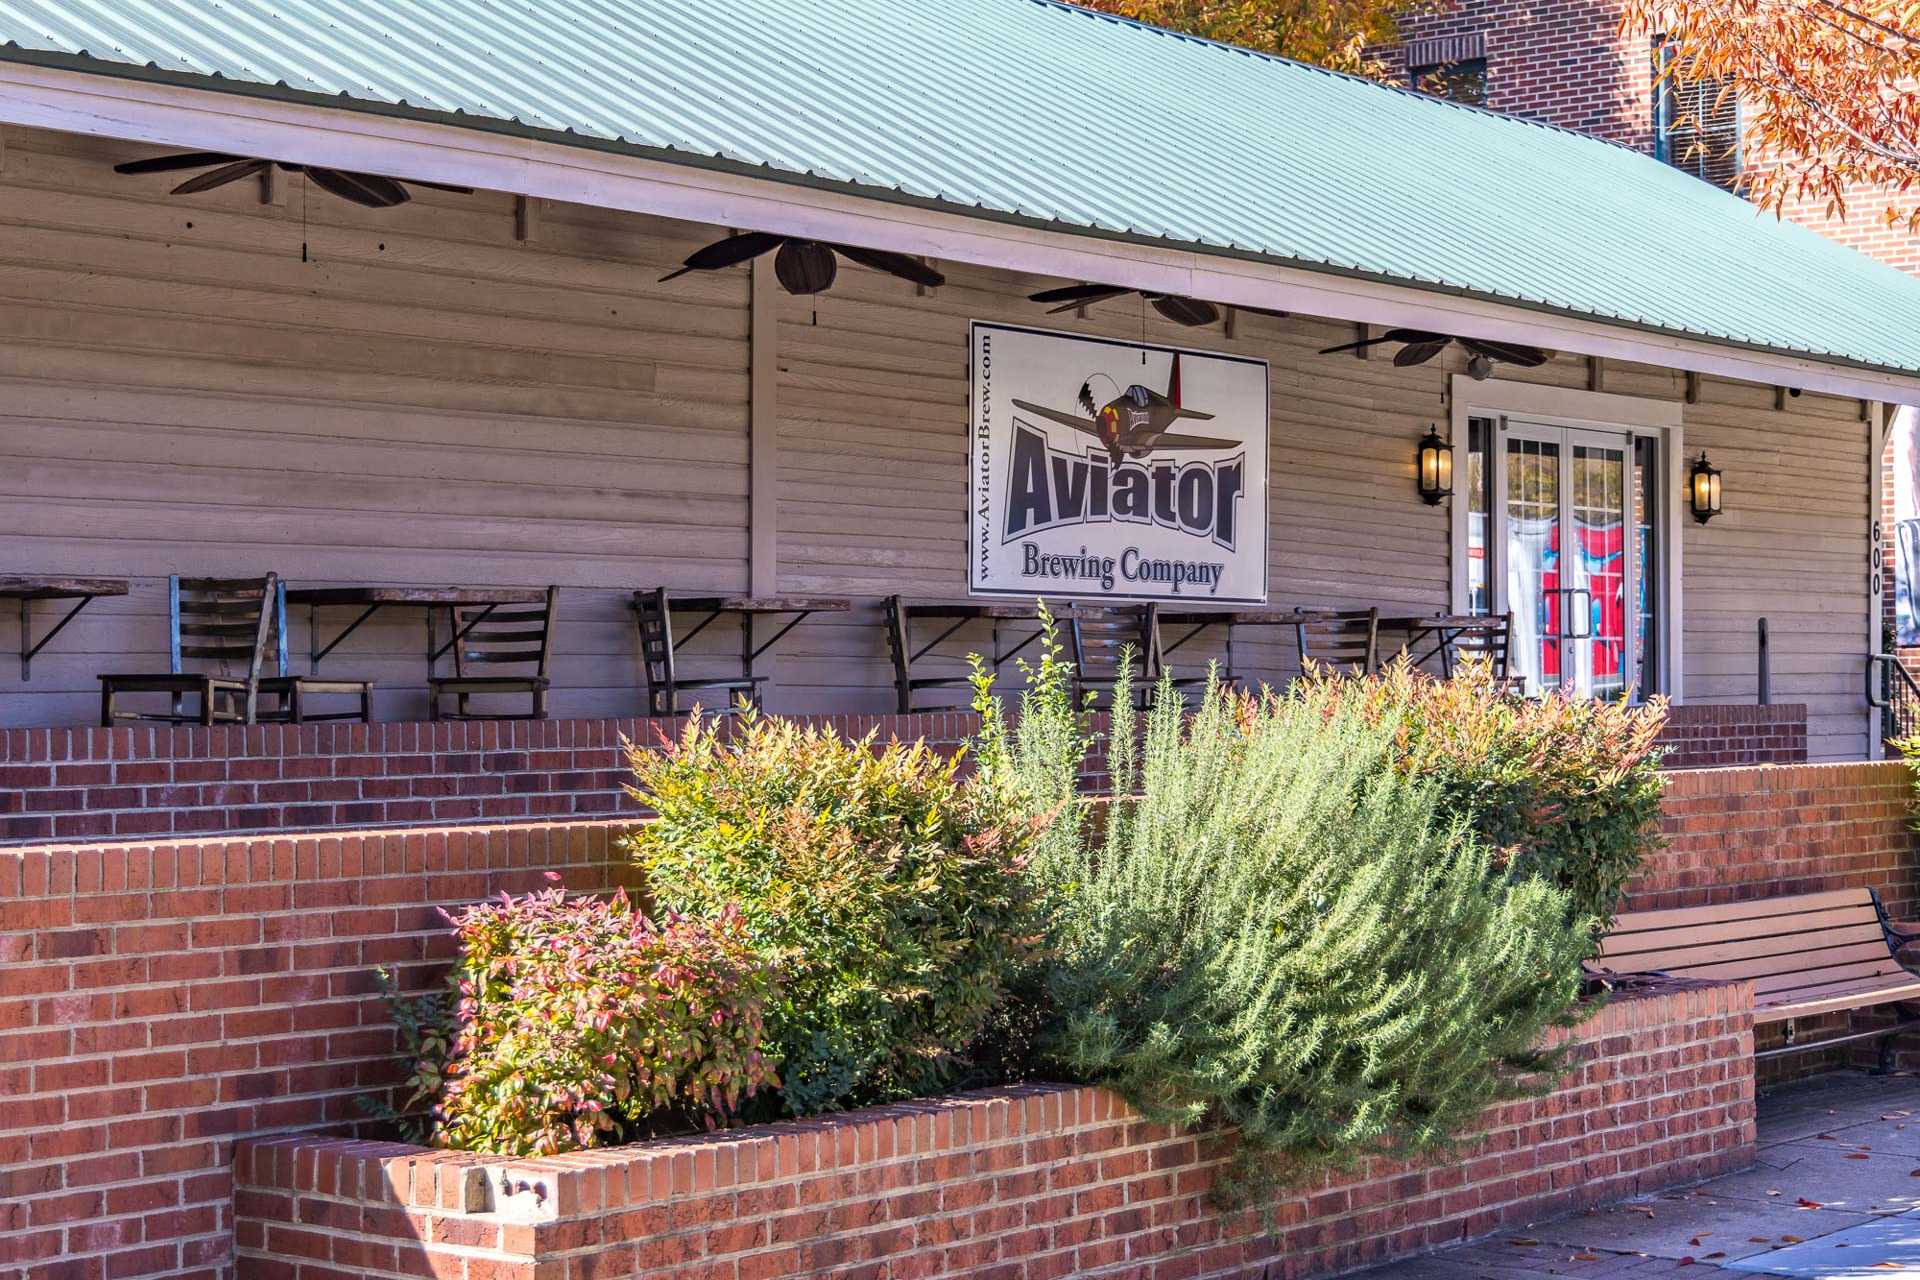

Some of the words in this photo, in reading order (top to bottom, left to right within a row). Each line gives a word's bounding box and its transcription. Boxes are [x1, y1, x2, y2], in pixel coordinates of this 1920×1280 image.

[977, 335, 991, 582] www.AviatorBrew.com
[1002, 417, 1244, 552] Aviator
[1022, 543, 1114, 590] Brewing
[1120, 547, 1224, 594] Company
